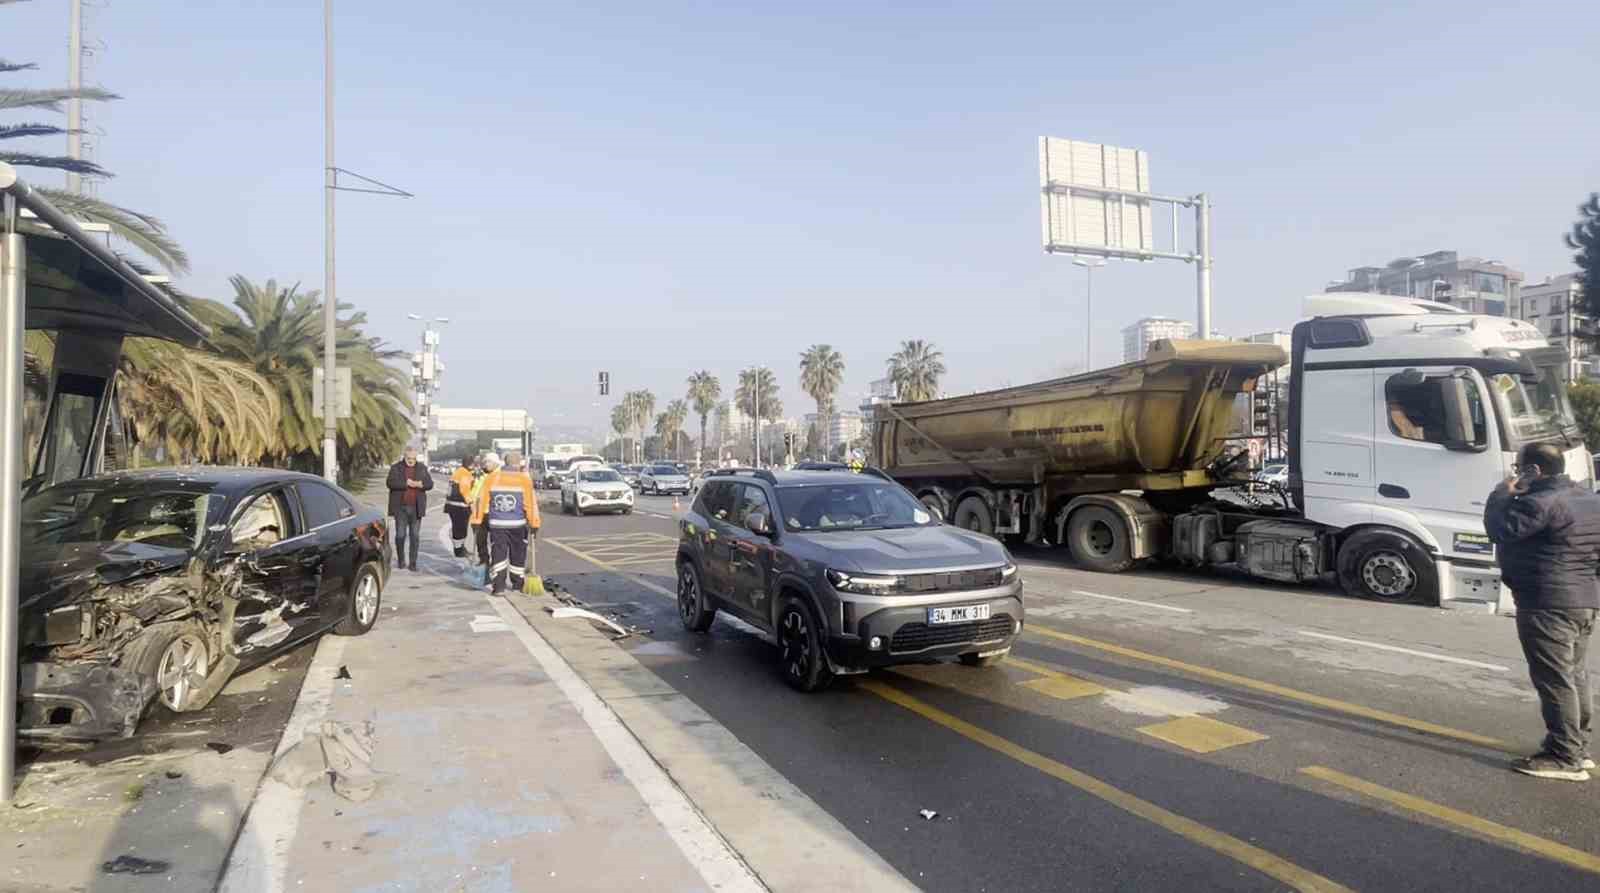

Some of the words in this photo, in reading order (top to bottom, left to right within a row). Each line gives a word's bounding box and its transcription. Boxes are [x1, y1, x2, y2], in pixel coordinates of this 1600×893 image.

[935, 610, 945, 621] 34
[951, 607, 968, 620] MMK
[973, 606, 988, 618] 311
